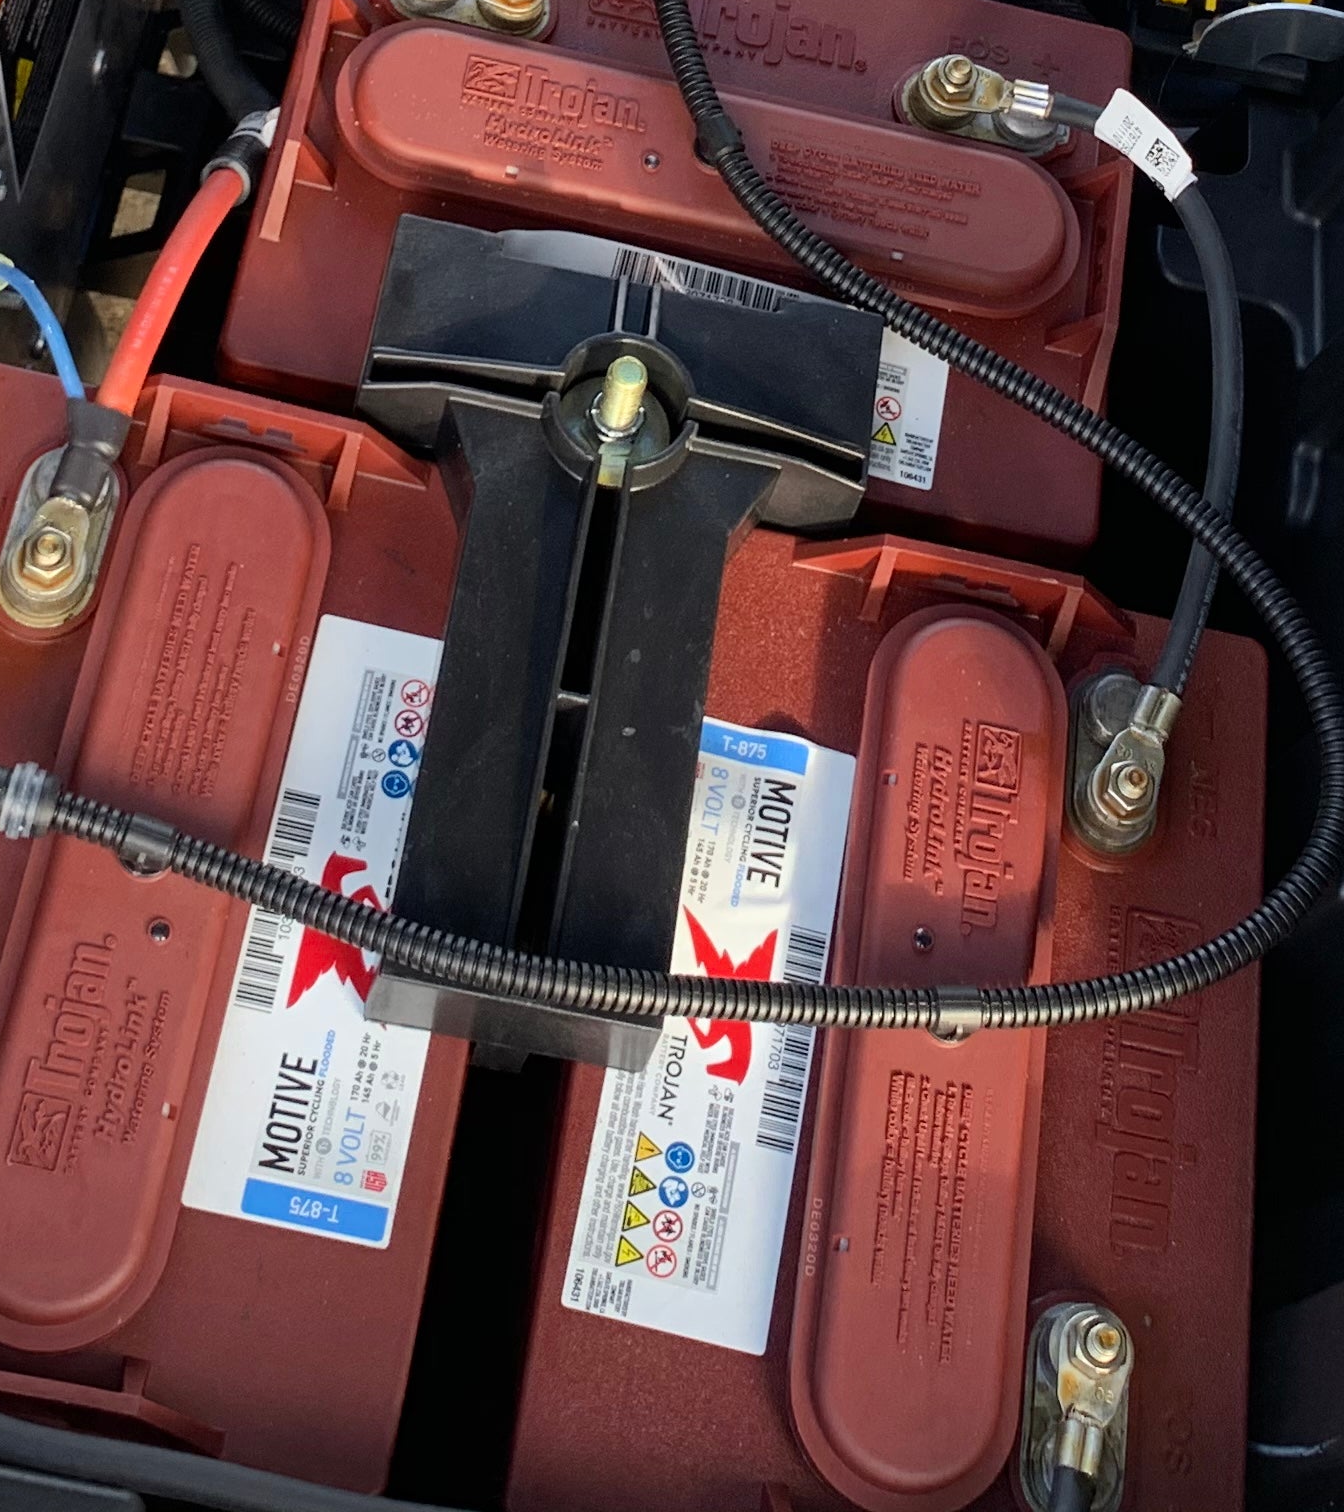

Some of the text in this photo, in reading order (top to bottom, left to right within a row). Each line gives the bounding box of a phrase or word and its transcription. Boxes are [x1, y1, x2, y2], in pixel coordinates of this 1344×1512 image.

[947, 34, 1009, 64] POS
[525, 68, 639, 134] Trojan
[900, 470, 925, 483] 106431
[721, 735, 768, 760] T-875
[700, 766, 728, 835] 8 VOLT
[746, 776, 762, 820] SUPERIOR
[901, 744, 927, 881] Watering System
[919, 747, 954, 876] HydroLink
[706, 839, 715, 856] 170
[738, 823, 753, 862] CYCLING
[746, 779, 797, 885] MOTIVE
[691, 854, 702, 866] Ah
[702, 857, 713, 868] Ah
[950, 789, 1018, 928] Trojan
[686, 884, 696, 896] Hr
[696, 892, 706, 904] Hr
[698, 879, 708, 891] 20
[29, 940, 120, 1095] Trojan
[358, 1046, 369, 1057] 20
[362, 1031, 371, 1045] Hr
[372, 1038, 381, 1052] Hr
[95, 995, 148, 1136] HydroLink
[121, 989, 171, 1142] Watering System
[352, 1070, 364, 1082] Ah
[363, 1072, 375, 1085] Ah
[655, 1036, 688, 1119] TROJAN
[297, 1029, 336, 1175] SUPERIOR CYCLING FLOODED
[322, 1078, 341, 1134] TECHNOLOGY
[349, 1084, 360, 1101] 170
[361, 1086, 371, 1104] 145
[646, 1067, 665, 1115] COMPANY
[259, 1054, 317, 1171] MOTIVE
[332, 1107, 366, 1186] 8 VOLT
[371, 1134, 386, 1161] 99%
[289, 1195, 342, 1222] T-875
[567, 1267, 585, 1303] 106431
